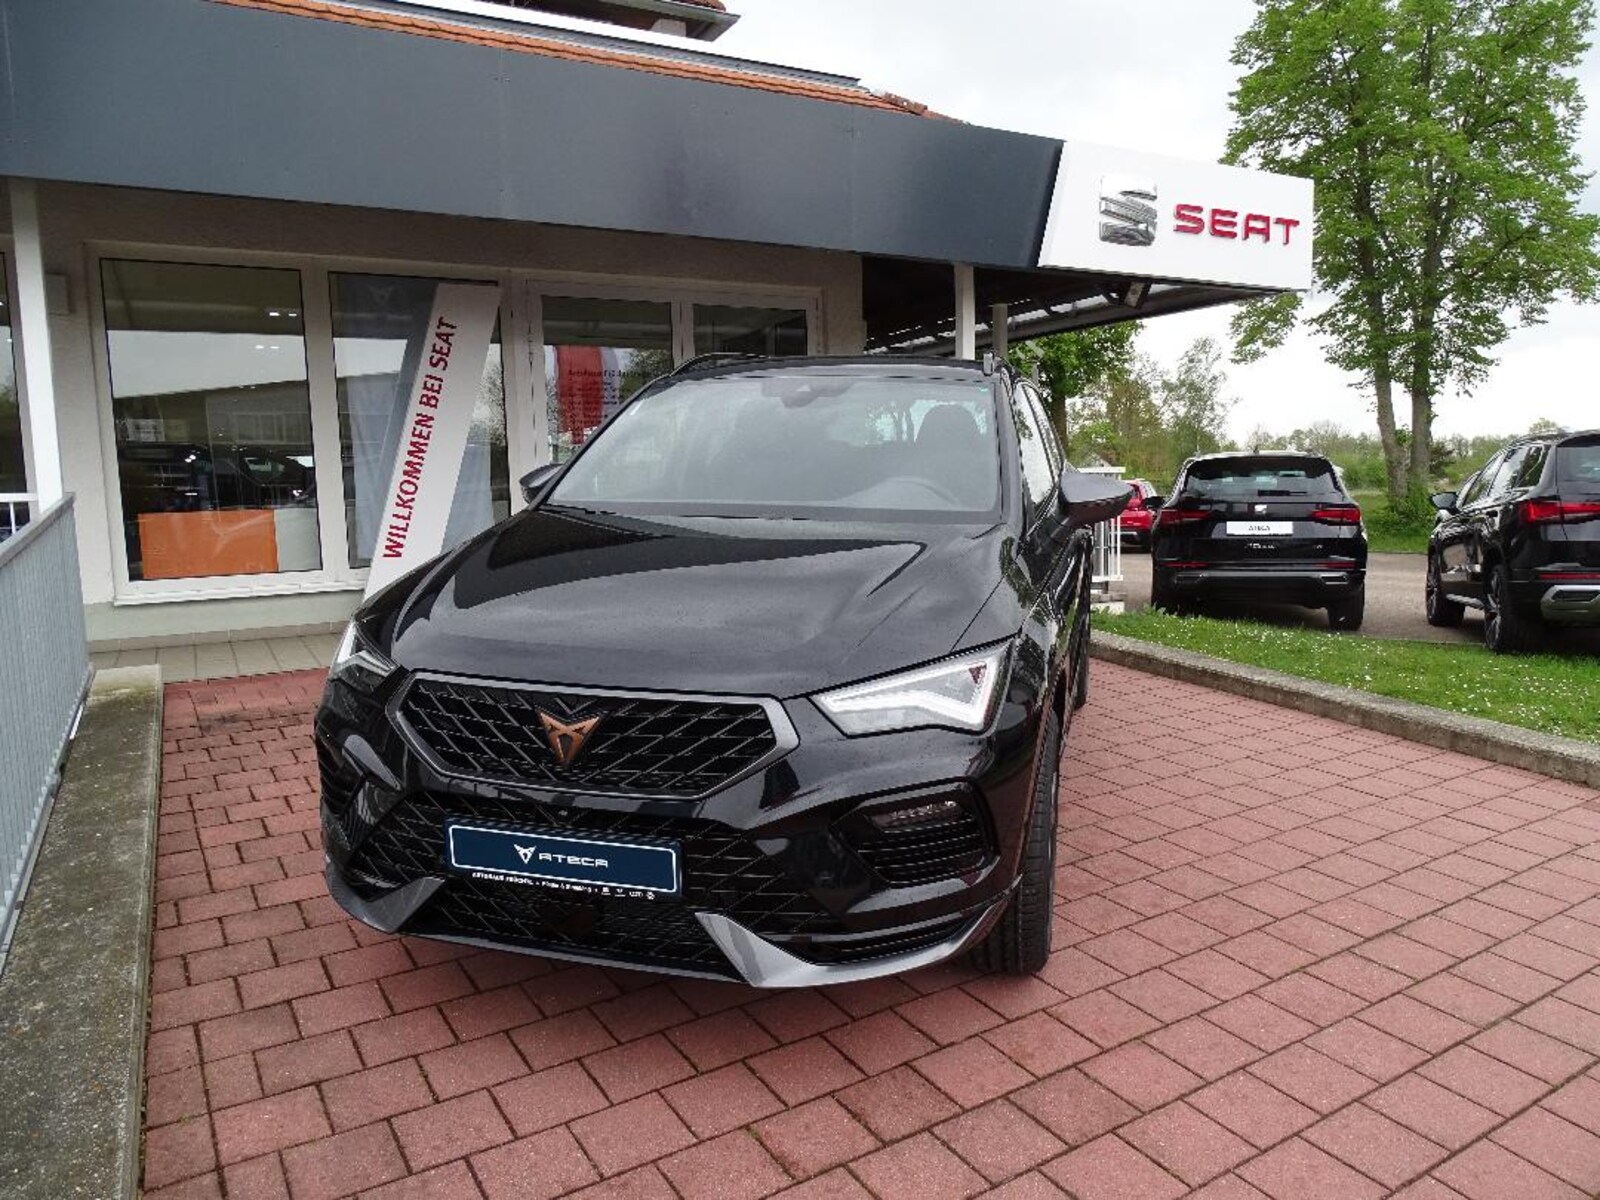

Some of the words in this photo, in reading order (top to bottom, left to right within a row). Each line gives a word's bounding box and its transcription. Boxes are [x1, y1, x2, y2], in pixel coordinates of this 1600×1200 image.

[1173, 203, 1300, 245] SEAT
[429, 316, 457, 371] SEAT
[419, 374, 443, 410] BEI
[383, 412, 434, 558] WILLKOMMEN
[538, 851, 609, 869] ATECA
